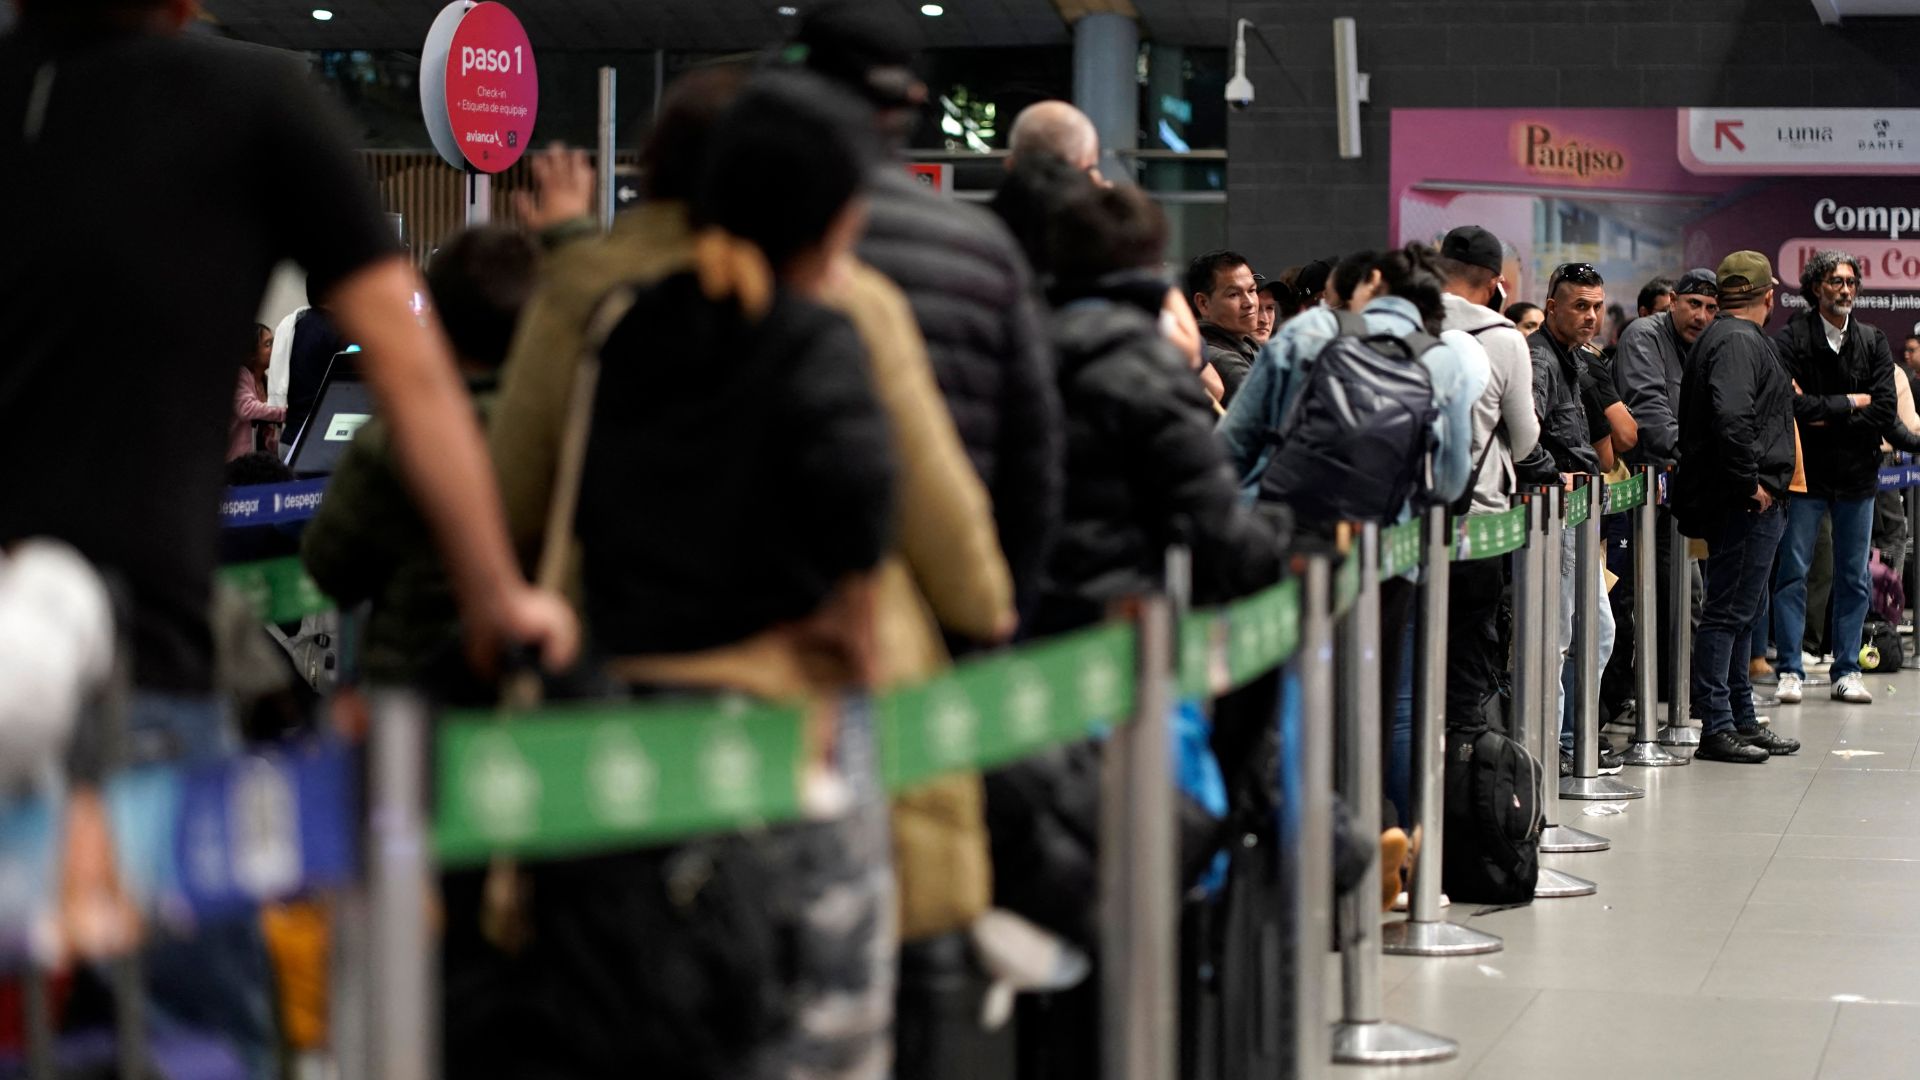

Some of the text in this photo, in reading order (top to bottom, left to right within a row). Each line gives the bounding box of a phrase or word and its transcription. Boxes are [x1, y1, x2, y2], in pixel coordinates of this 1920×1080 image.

[462, 45, 522, 76] paso 1
[477, 85, 507, 98] Check-in
[462, 98, 489, 112] Etiqueta
[490, 102, 499, 113] de
[499, 104, 528, 117] equipaje
[466, 129, 495, 143] avianca
[219, 499, 259, 517] espegar
